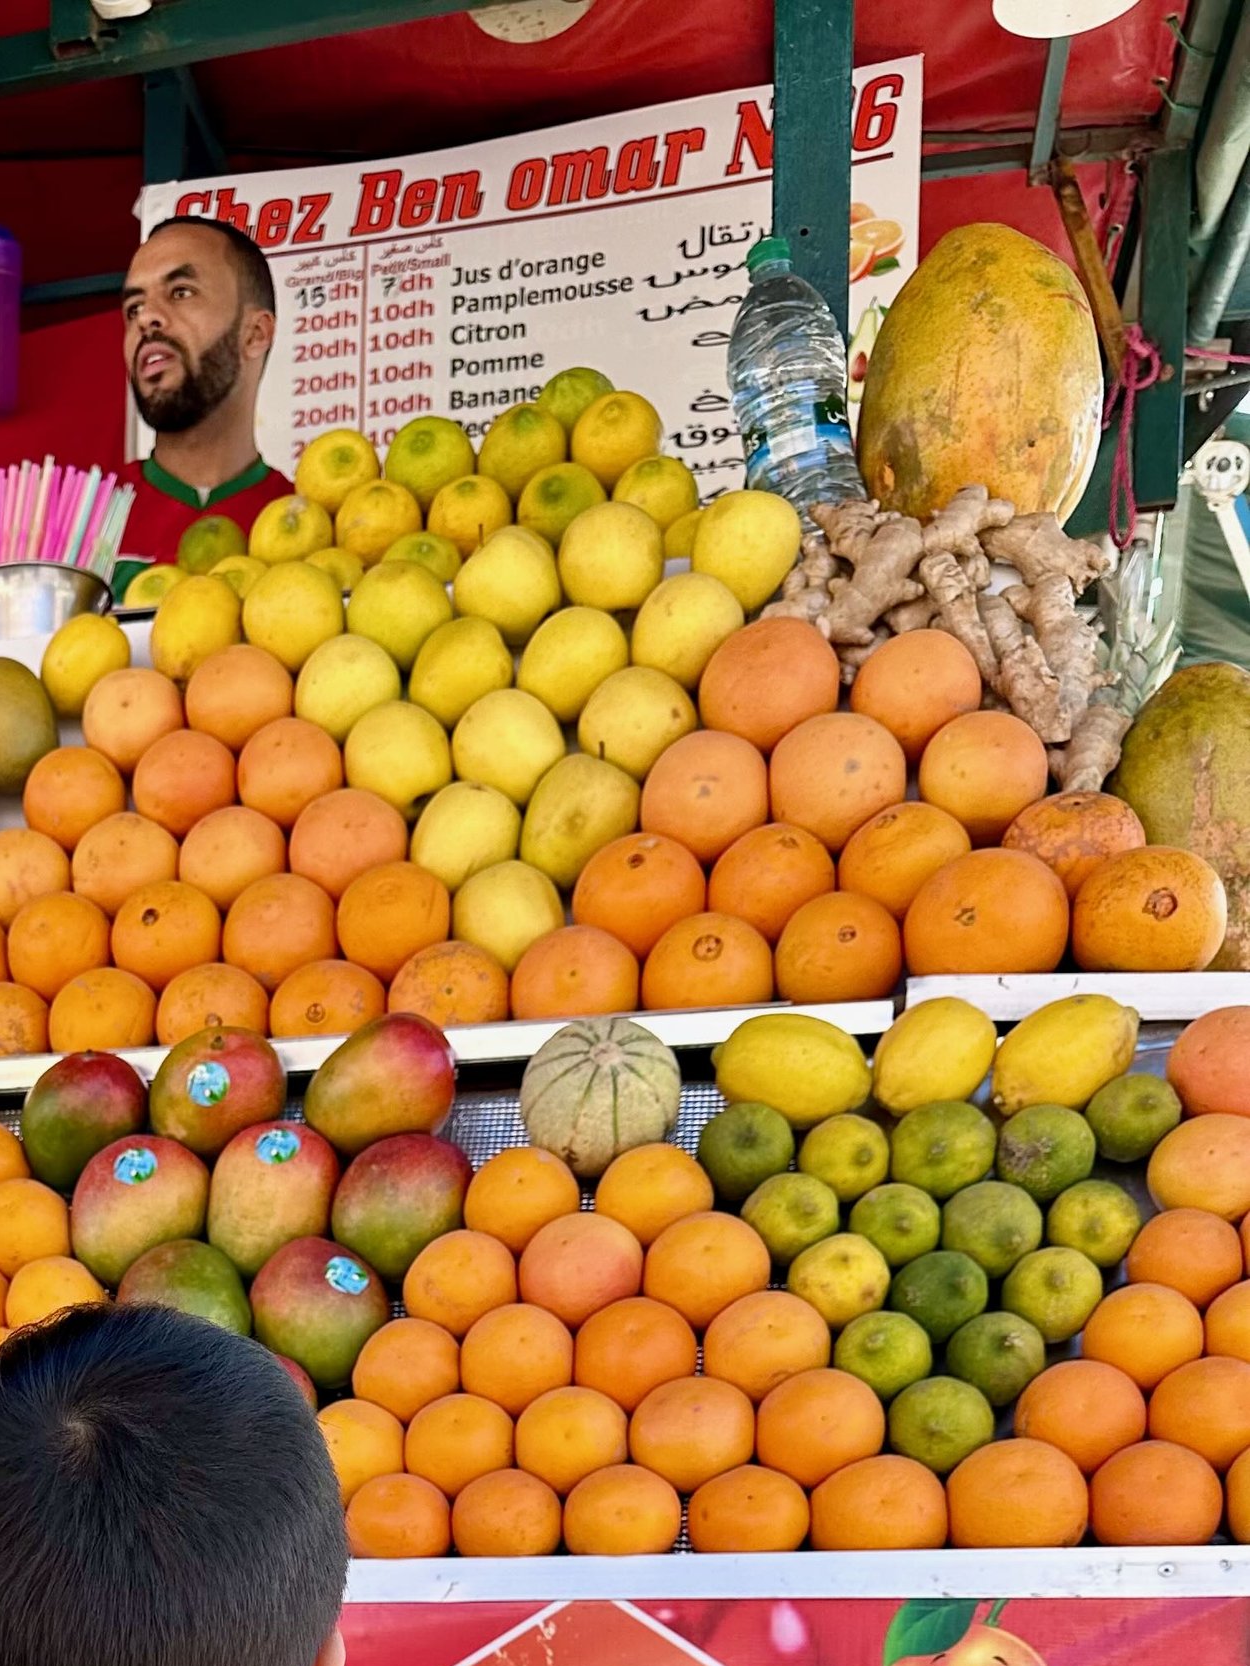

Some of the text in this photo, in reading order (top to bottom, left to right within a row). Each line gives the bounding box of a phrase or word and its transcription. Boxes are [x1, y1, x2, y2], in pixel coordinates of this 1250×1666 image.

[350, 168, 484, 237] Ben
[505, 126, 706, 211] omar
[851, 73, 904, 152] 6
[450, 252, 606, 287] Jus d'orange
[451, 275, 634, 316] Pamplemousse
[294, 310, 358, 335] 20dh
[369, 300, 434, 325] 10dh
[369, 329, 434, 353] 10dh
[450, 322, 526, 346] Citron
[294, 339, 358, 364] 20dh
[368, 361, 433, 386] 10dh
[449, 352, 544, 378] Pomme
[294, 371, 357, 396] 20dh
[368, 393, 432, 418] 10dh
[449, 385, 542, 410] Banane
[293, 403, 356, 429] 20dh
